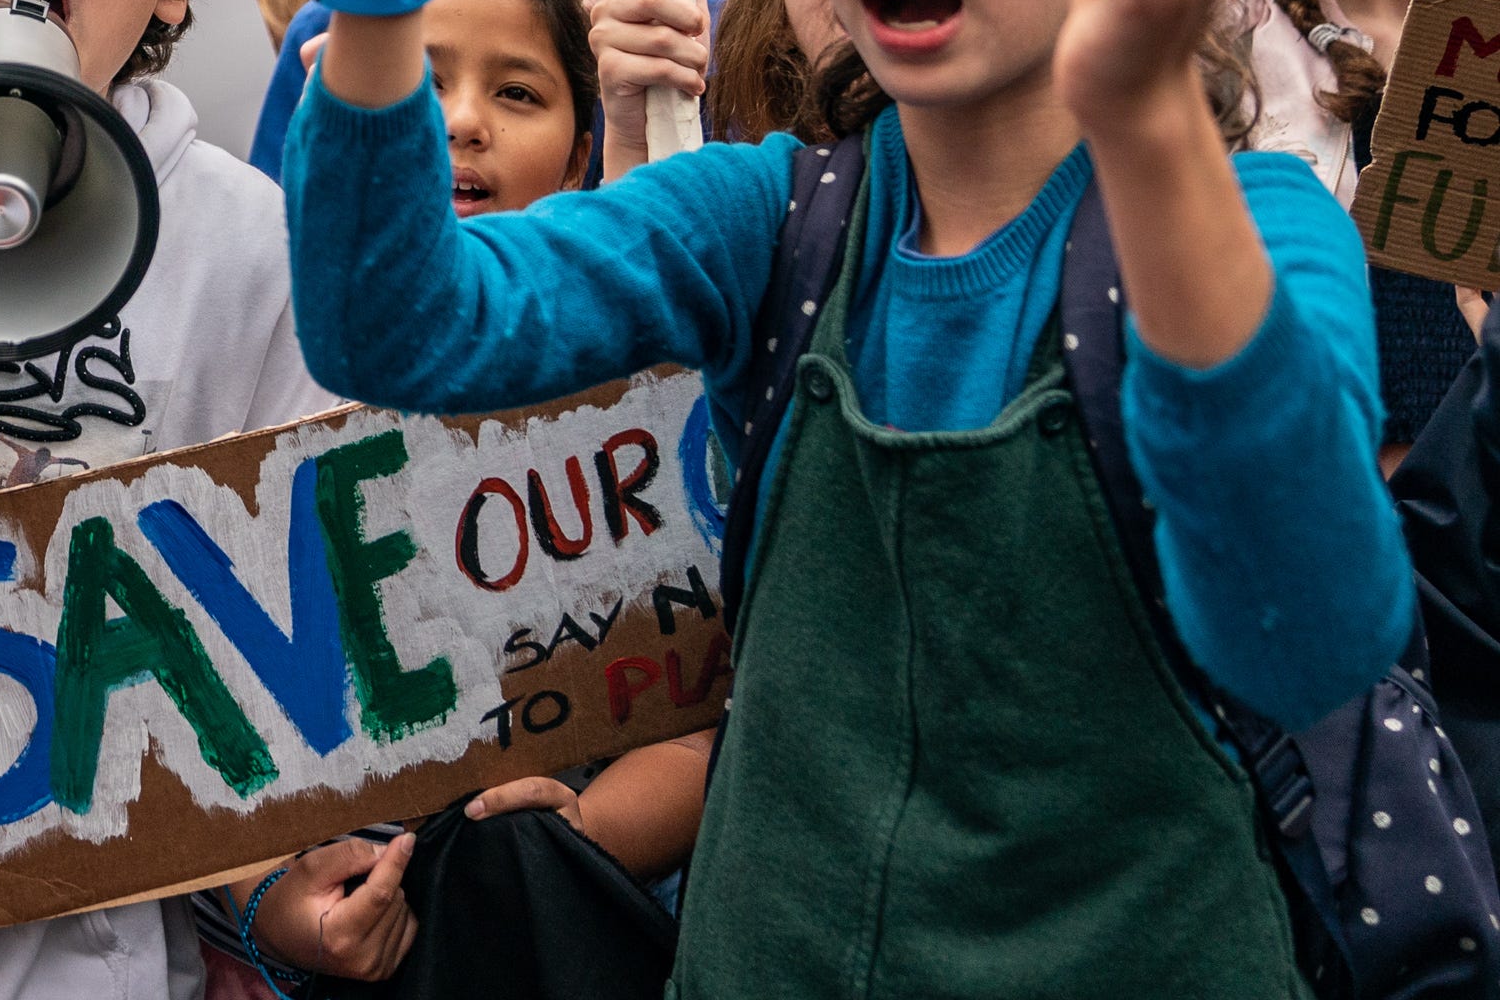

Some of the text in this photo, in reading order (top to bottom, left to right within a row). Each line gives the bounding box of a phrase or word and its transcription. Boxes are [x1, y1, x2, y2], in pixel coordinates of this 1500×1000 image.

[455, 428, 665, 592] OUR
[503, 596, 624, 674] SAY
[479, 690, 571, 751] TO
